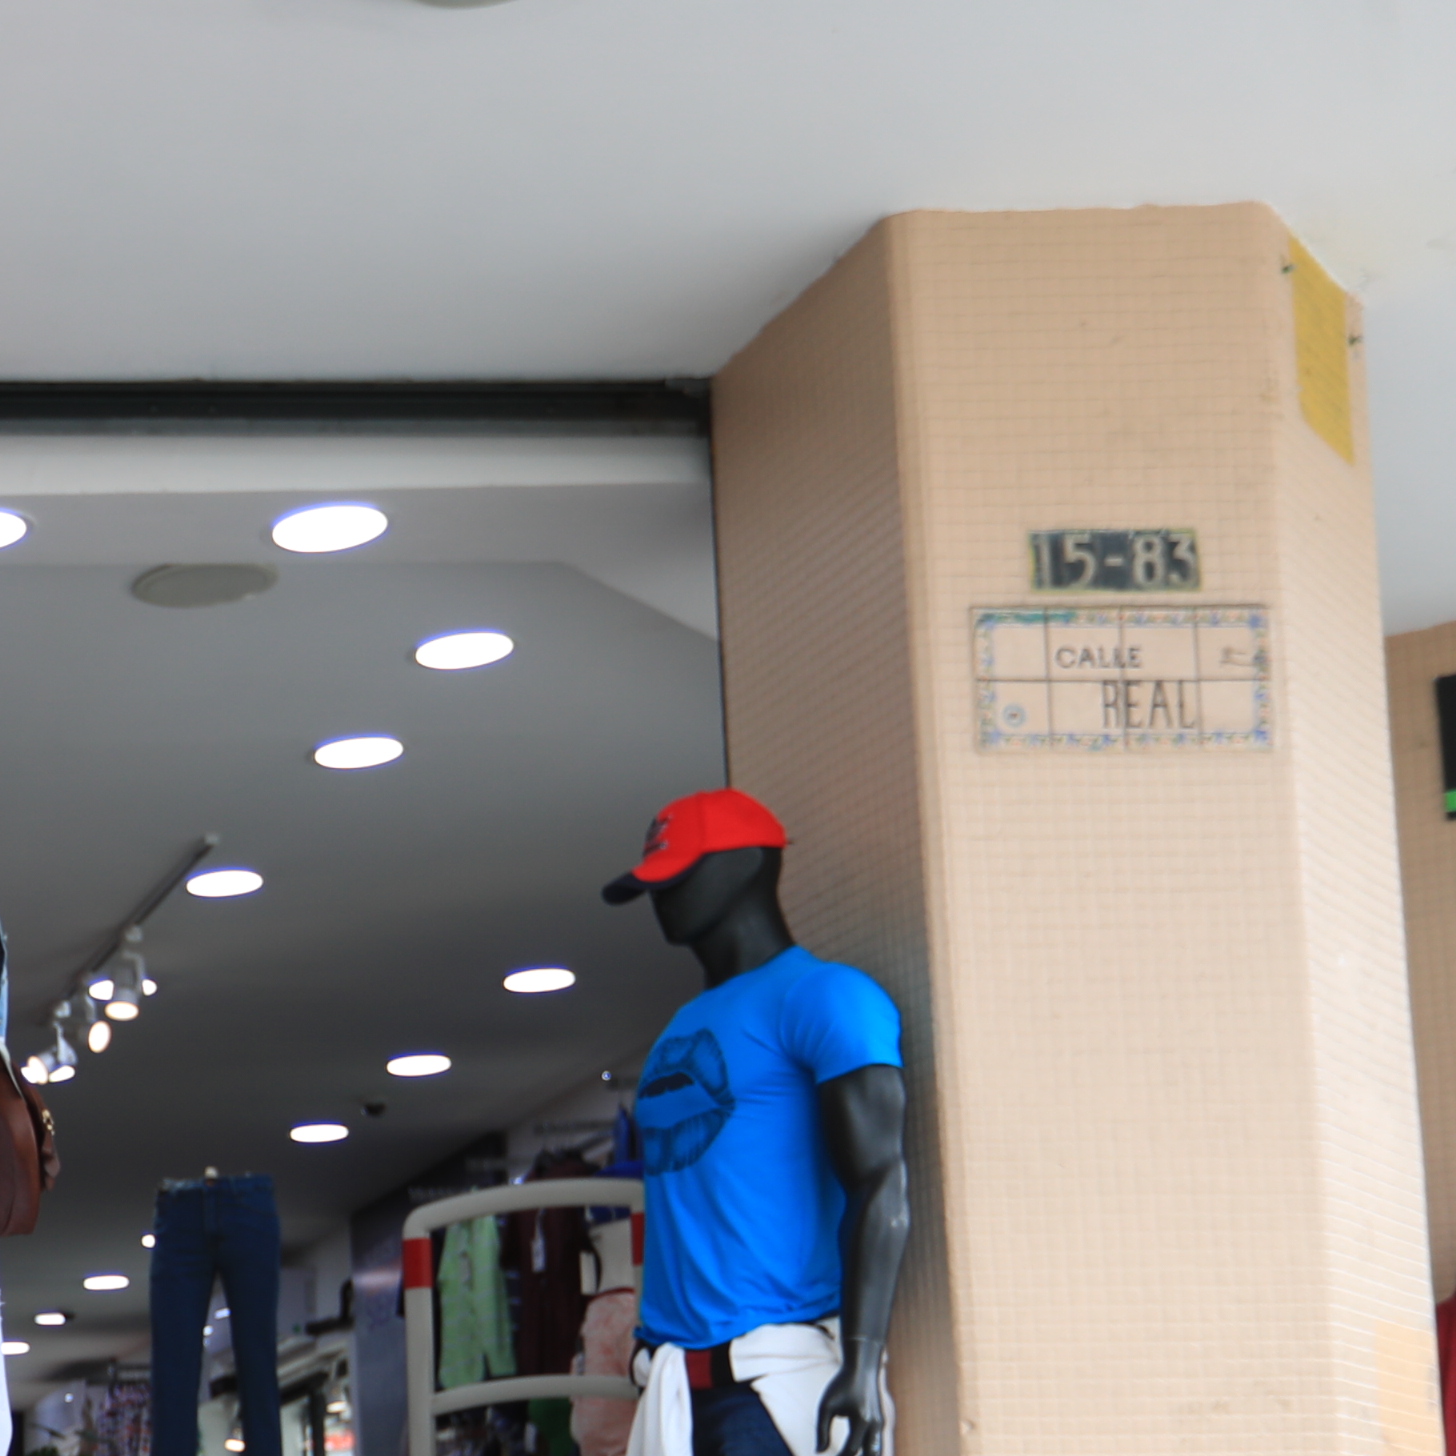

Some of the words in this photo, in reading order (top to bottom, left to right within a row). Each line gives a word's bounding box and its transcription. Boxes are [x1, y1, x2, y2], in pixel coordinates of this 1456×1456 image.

[1033, 532, 1199, 589] 15-83
[1055, 645, 1143, 669] CALLE
[1101, 679, 1196, 729] REAL
